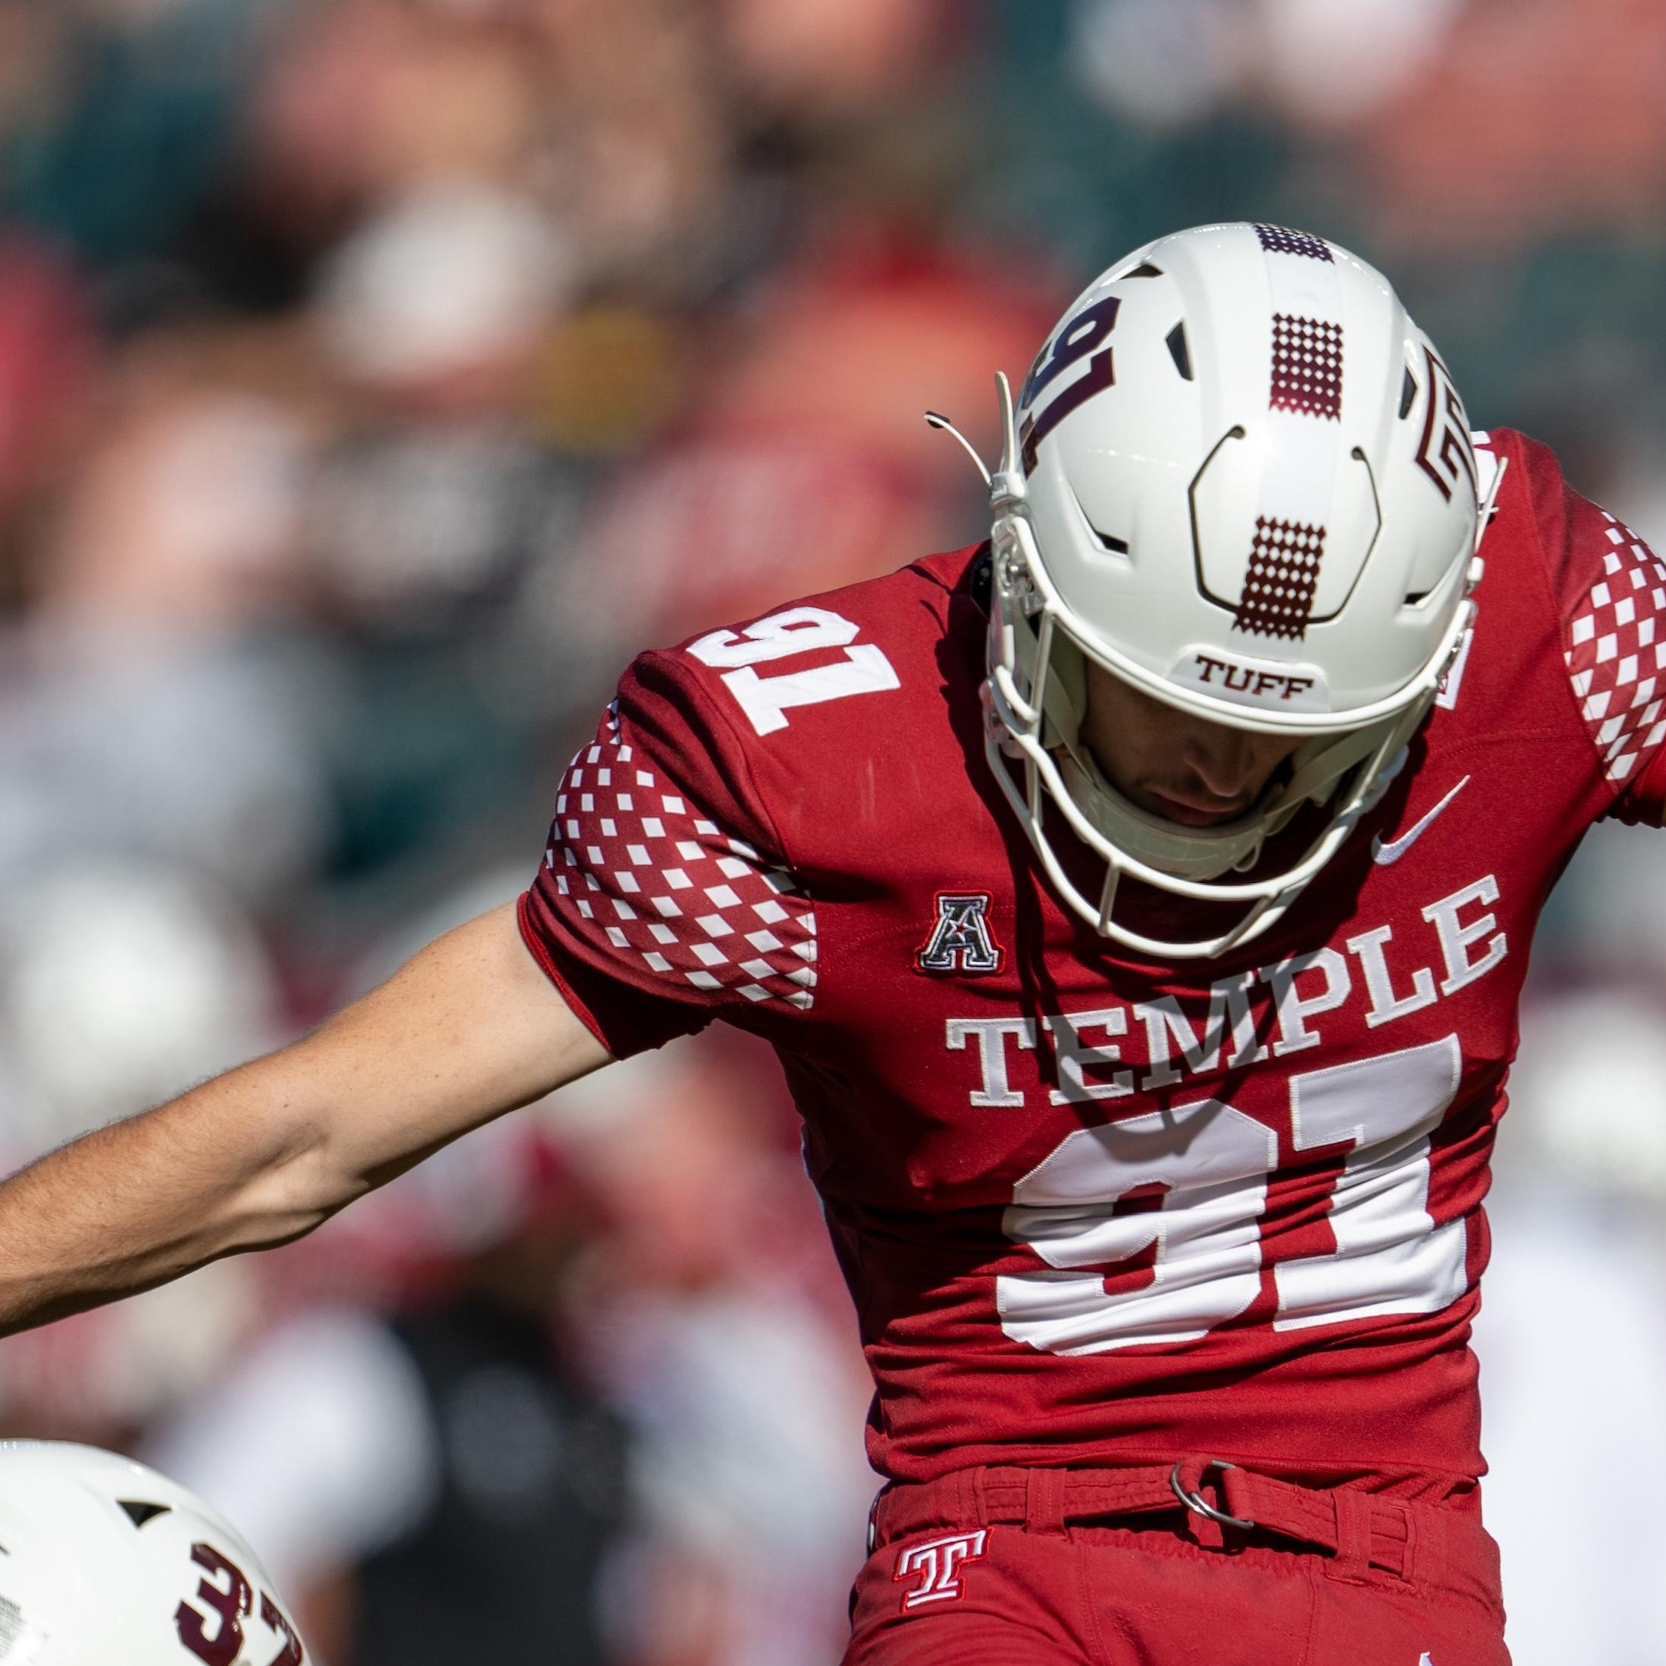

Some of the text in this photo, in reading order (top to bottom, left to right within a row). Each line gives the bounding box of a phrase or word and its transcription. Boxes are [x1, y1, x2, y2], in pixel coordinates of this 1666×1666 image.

[1019, 296, 1122, 481] 91
[685, 606, 902, 738] 91
[1194, 653, 1315, 700] TUFF
[944, 874, 1510, 1110] TEMPLE
[996, 1032, 1468, 1358] 91
